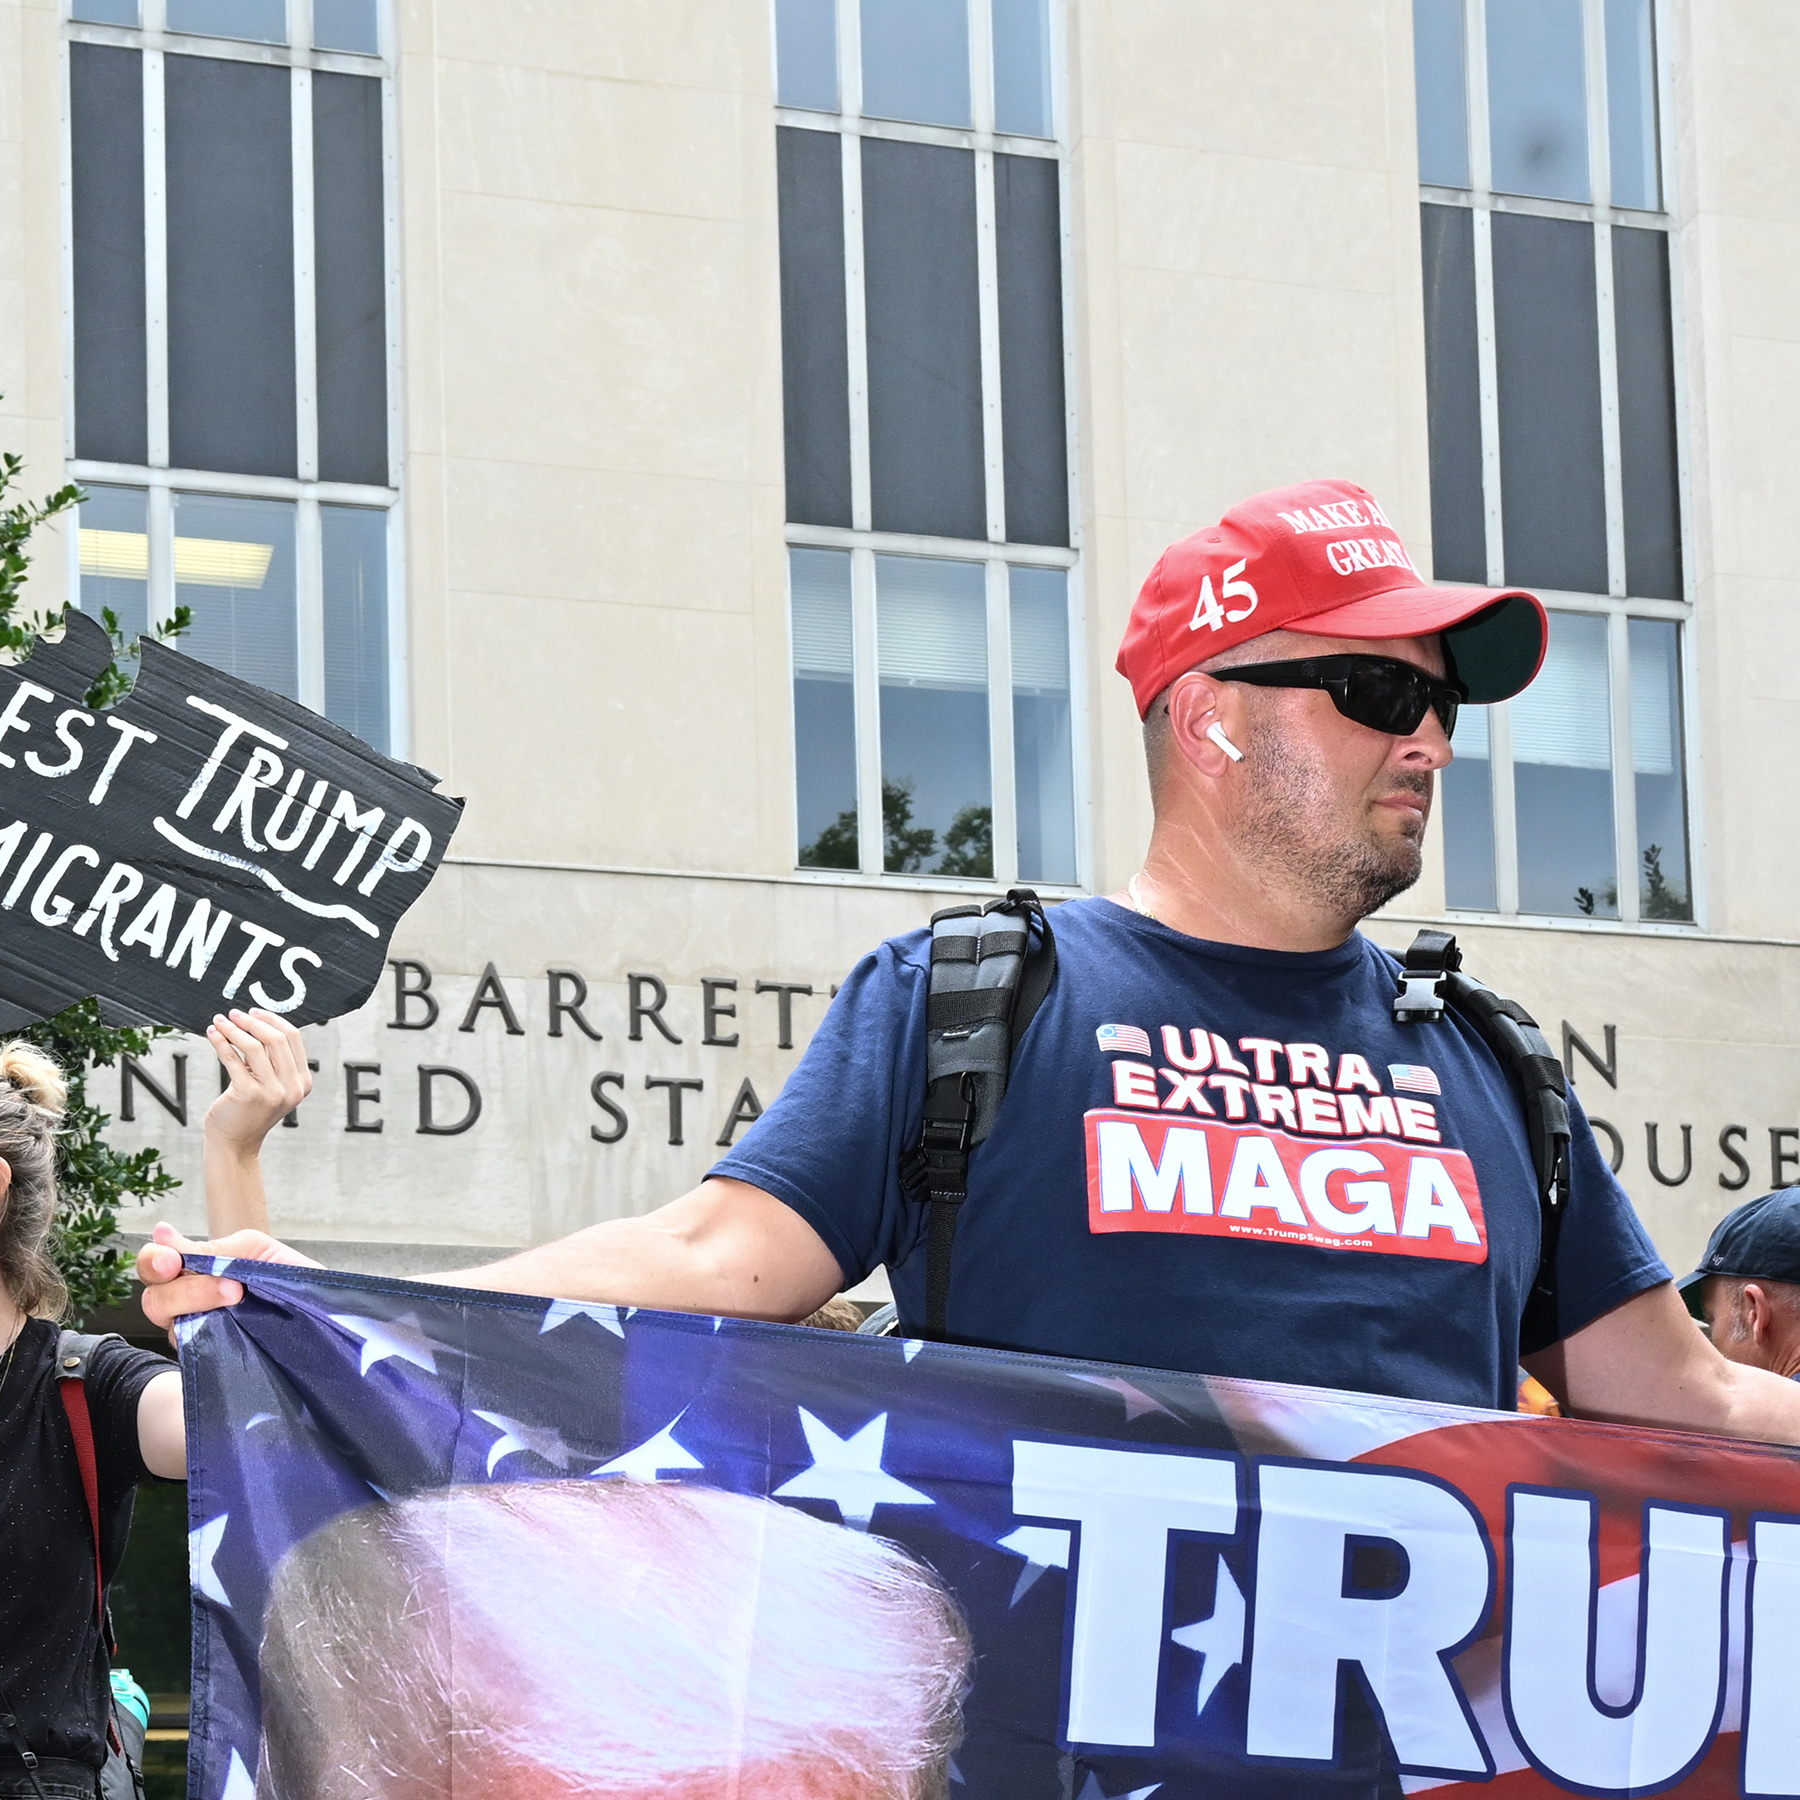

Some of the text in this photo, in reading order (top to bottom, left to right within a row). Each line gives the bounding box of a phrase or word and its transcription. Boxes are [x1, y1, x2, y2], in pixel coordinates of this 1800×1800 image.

[1277, 499, 1394, 534] MAKE A
[1188, 556, 1259, 632] 45
[176, 695, 432, 898] TRUMP
[387, 958, 1618, 1090] BARRET N
[1158, 1024, 1382, 1096] ULTRA
[119, 1052, 483, 1136] NED
[590, 1070, 764, 1147] STA
[1111, 1060, 1442, 1143] EXTREME
[1097, 1121, 1484, 1247] MAGA
[1228, 1224, 1374, 1247] www.TrumpSwag.com
